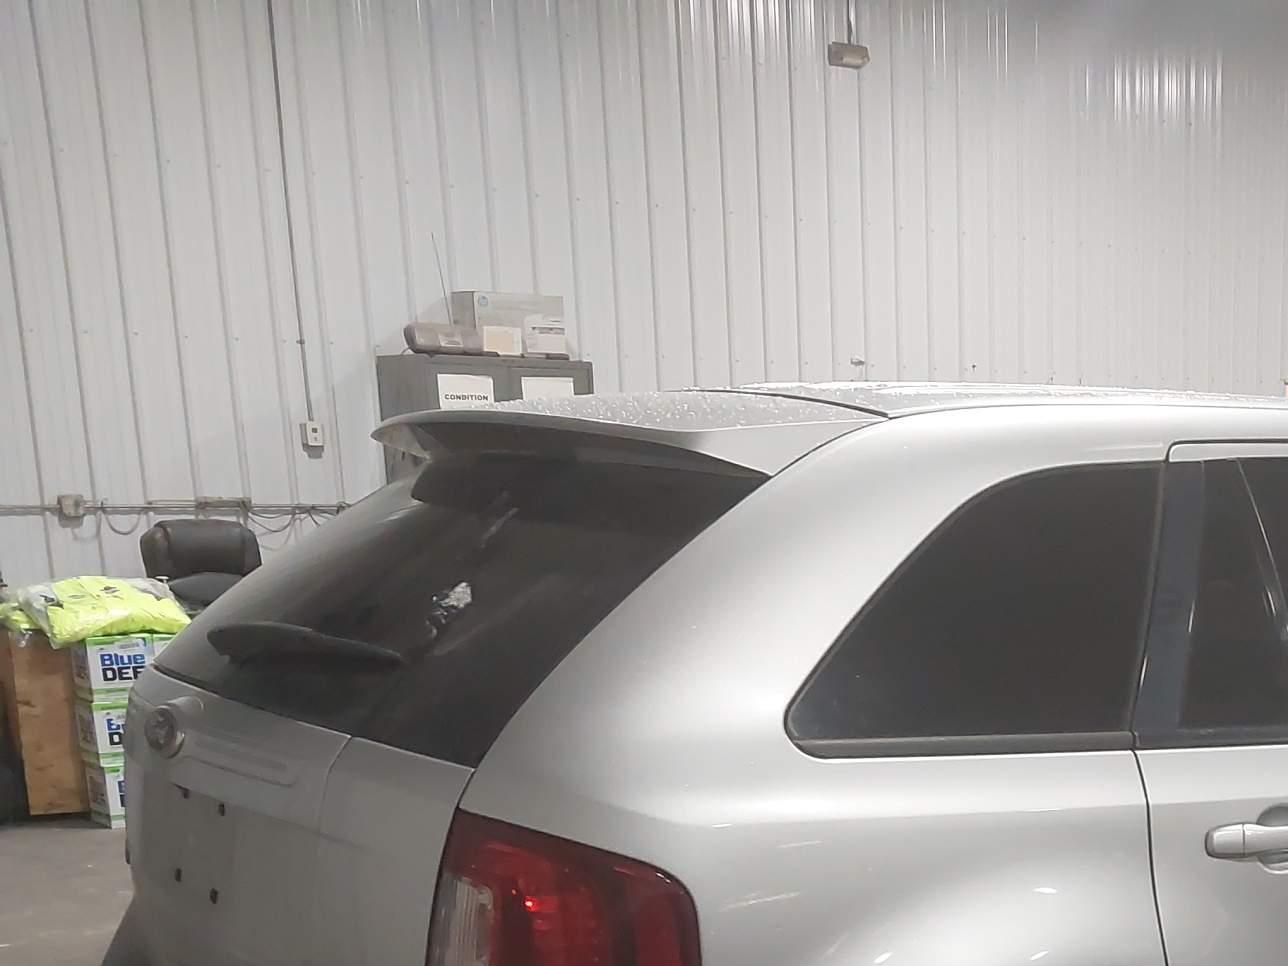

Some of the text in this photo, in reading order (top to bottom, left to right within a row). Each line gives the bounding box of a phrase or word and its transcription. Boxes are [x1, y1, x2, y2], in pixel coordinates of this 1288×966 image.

[444, 393, 488, 401] CONDITION
[100, 653, 146, 667] Blue
[102, 665, 146, 682] DEF
